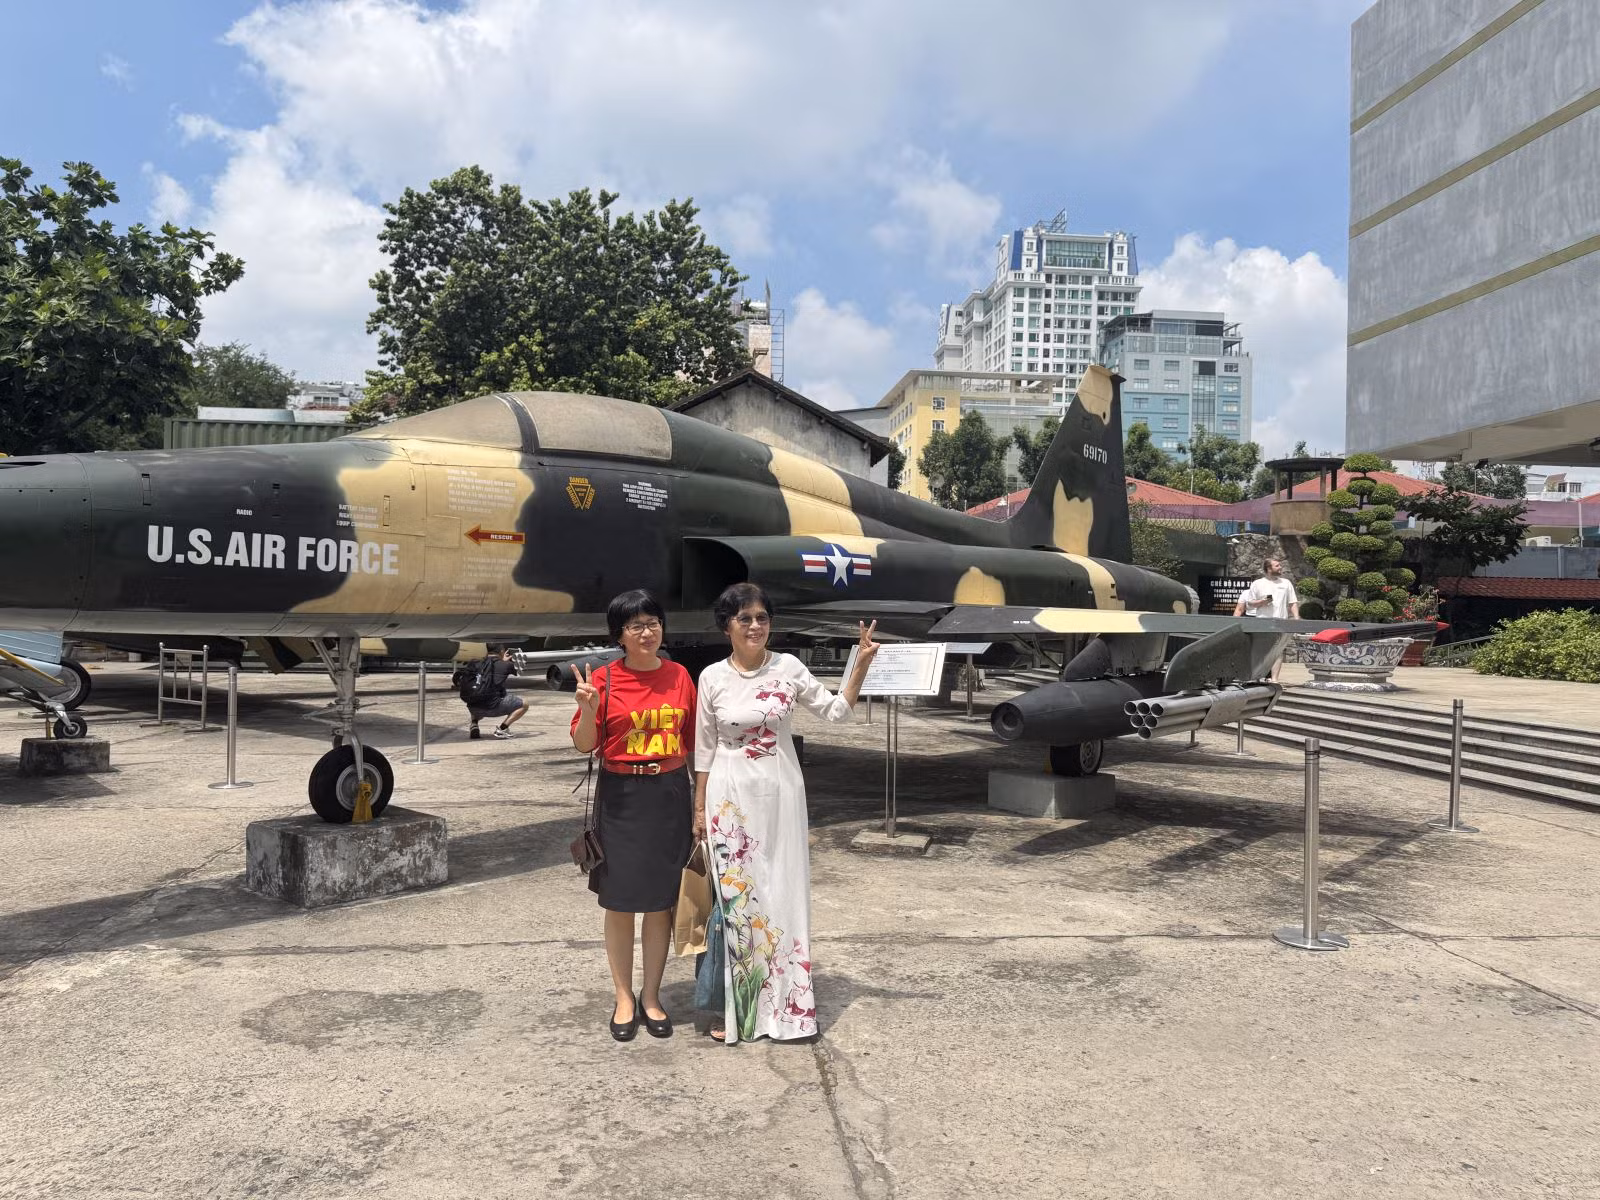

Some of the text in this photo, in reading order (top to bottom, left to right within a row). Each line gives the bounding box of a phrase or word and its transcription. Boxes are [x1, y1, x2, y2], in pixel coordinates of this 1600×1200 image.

[1083, 443, 1108, 464] 69170
[236, 508, 253, 516] RADIO
[298, 536, 399, 576] FORCE
[1233, 580, 1245, 588] LAO
[626, 733, 681, 755] NAM
